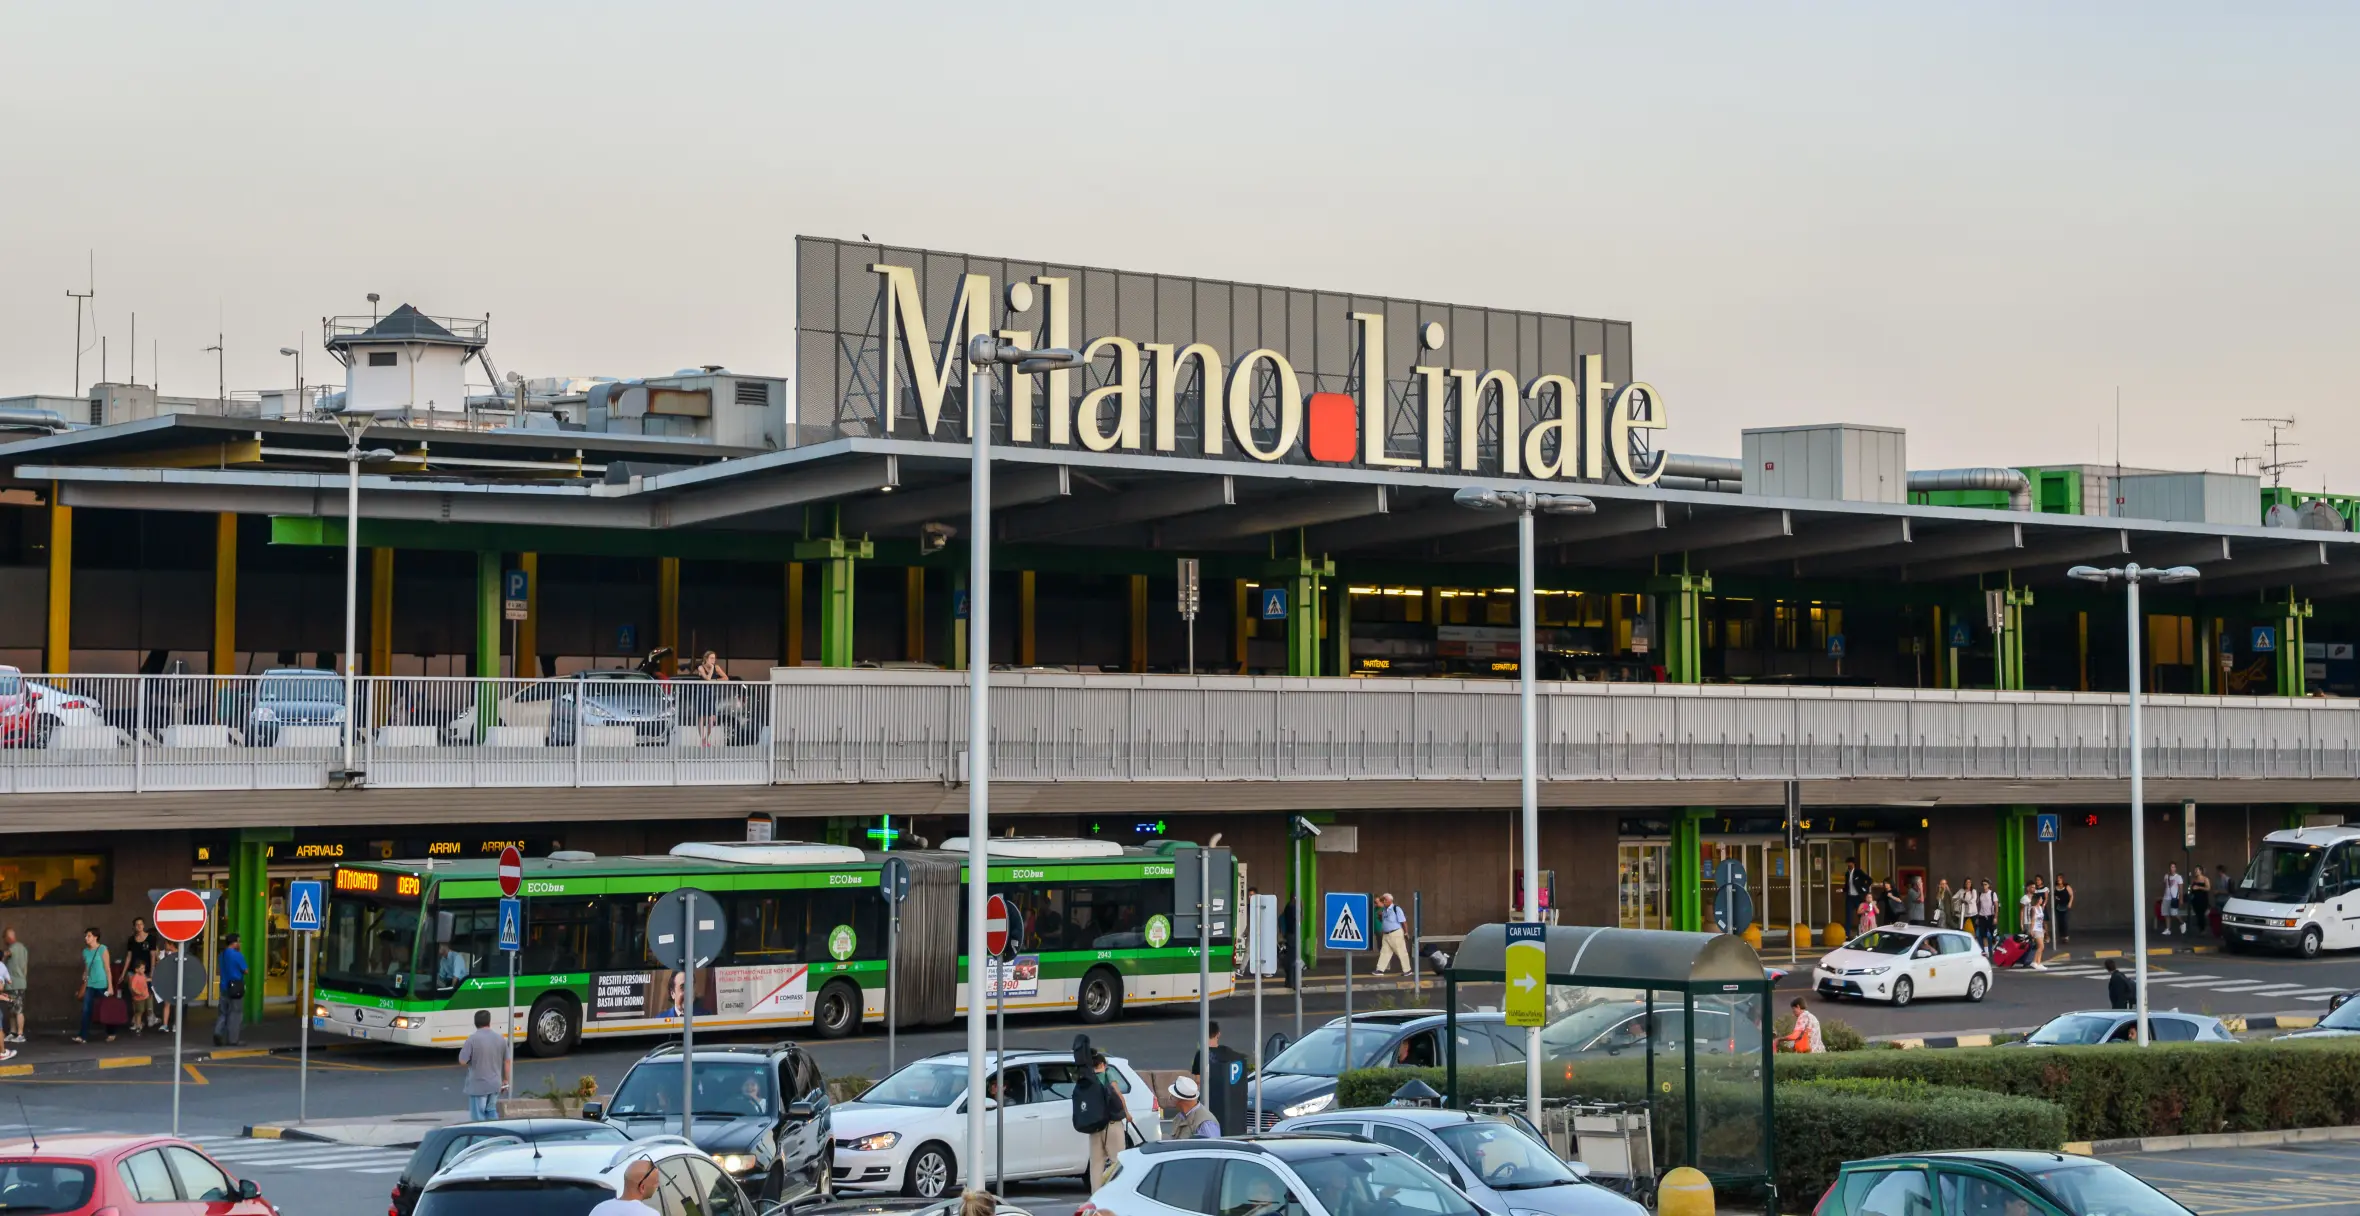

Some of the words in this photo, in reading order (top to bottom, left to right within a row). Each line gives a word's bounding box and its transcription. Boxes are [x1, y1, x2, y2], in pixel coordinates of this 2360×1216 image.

[866, 263, 1302, 462] Milano
[1347, 312, 1668, 485] Linate
[511, 575, 523, 596] P
[1363, 660, 1390, 668] PARTENZE
[296, 844, 344, 857] ARRIVALS
[429, 842, 461, 854] ARRIVI
[1012, 869, 1044, 879] ECObus
[1143, 865, 1174, 876] ECObus
[336, 869, 379, 891] ATMONATO
[399, 876, 420, 895] DEPO
[829, 874, 863, 885] ECObus
[527, 882, 565, 893] ECObus
[1509, 927, 1522, 937] CAR
[1522, 927, 1542, 937] VALET
[1097, 950, 1112, 960] 2943
[549, 976, 567, 985] 2943
[598, 975, 622, 986] PRESTITI
[622, 974, 652, 985] PERSONALI
[597, 986, 606, 997] DA
[606, 985, 631, 997] COMPASS
[379, 999, 394, 1009] 2943
[597, 997, 614, 1008] BASTA
[614, 997, 623, 1007] UN
[623, 995, 645, 1006] GIORNO
[1231, 1063, 1239, 1081] P
